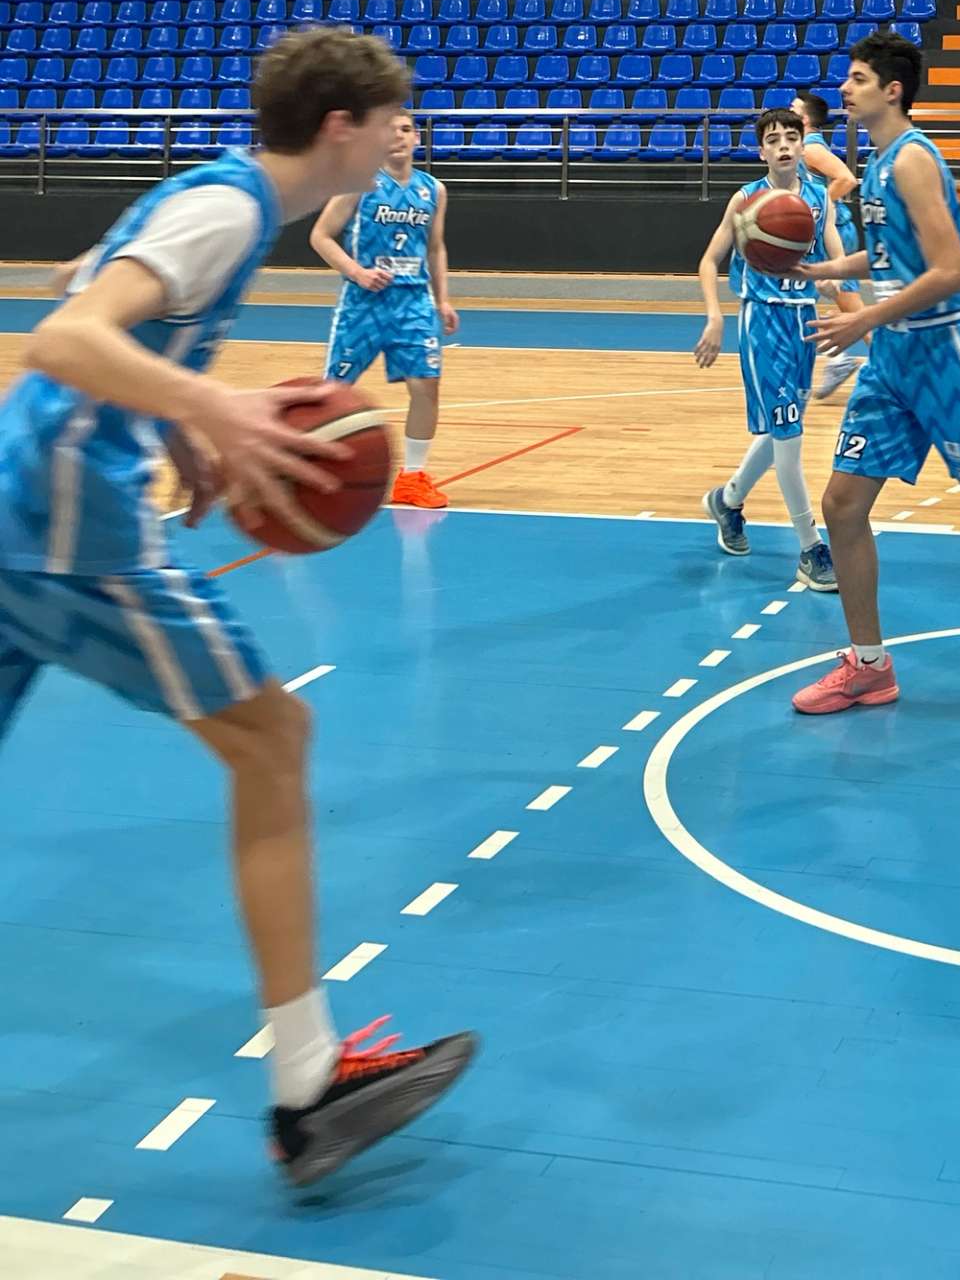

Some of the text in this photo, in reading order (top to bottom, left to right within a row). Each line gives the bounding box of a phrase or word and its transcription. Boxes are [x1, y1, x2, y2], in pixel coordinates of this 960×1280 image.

[373, 204, 431, 228] Rookie
[394, 233, 408, 251] 7
[338, 362, 352, 377] 7
[774, 402, 799, 426] 10
[835, 432, 867, 459] 12
